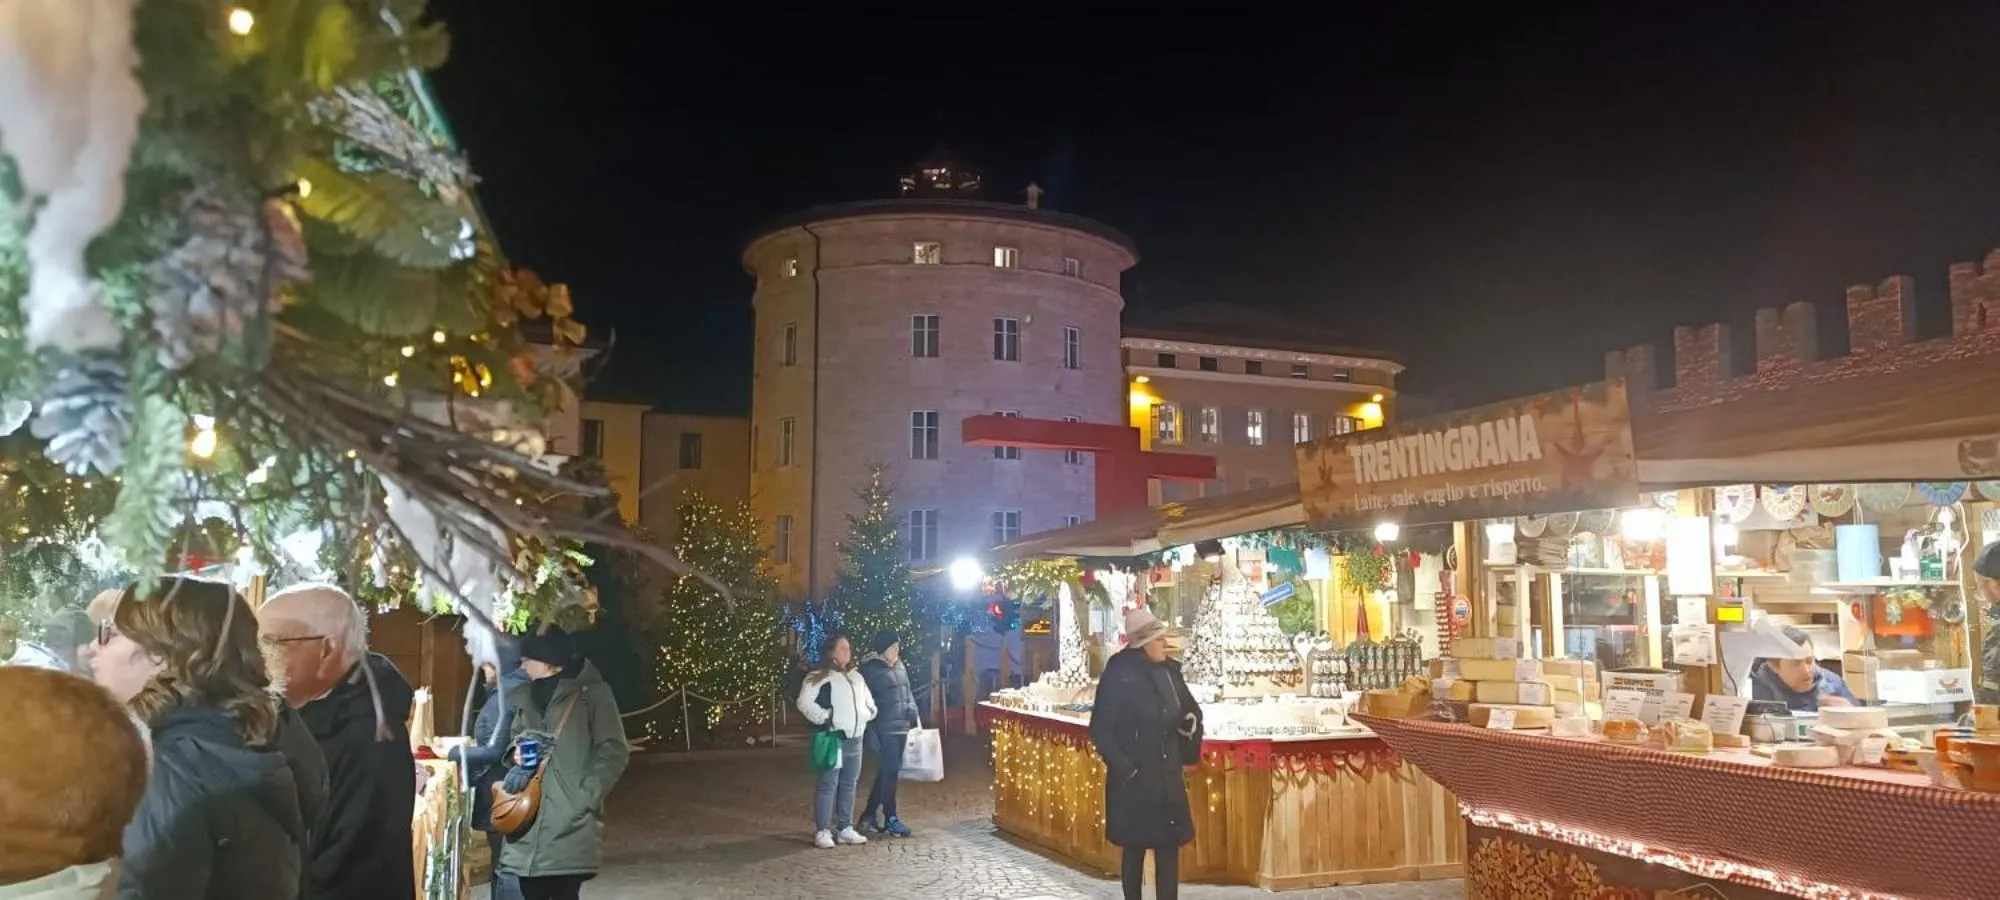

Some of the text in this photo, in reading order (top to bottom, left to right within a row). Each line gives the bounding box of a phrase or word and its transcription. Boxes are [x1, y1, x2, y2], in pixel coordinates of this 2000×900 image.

[1348, 414, 1541, 484] TRENTINGRANA
[1423, 482, 1464, 508] caglio
[1469, 484, 1477, 499] e
[1480, 478, 1547, 500] rispetto.
